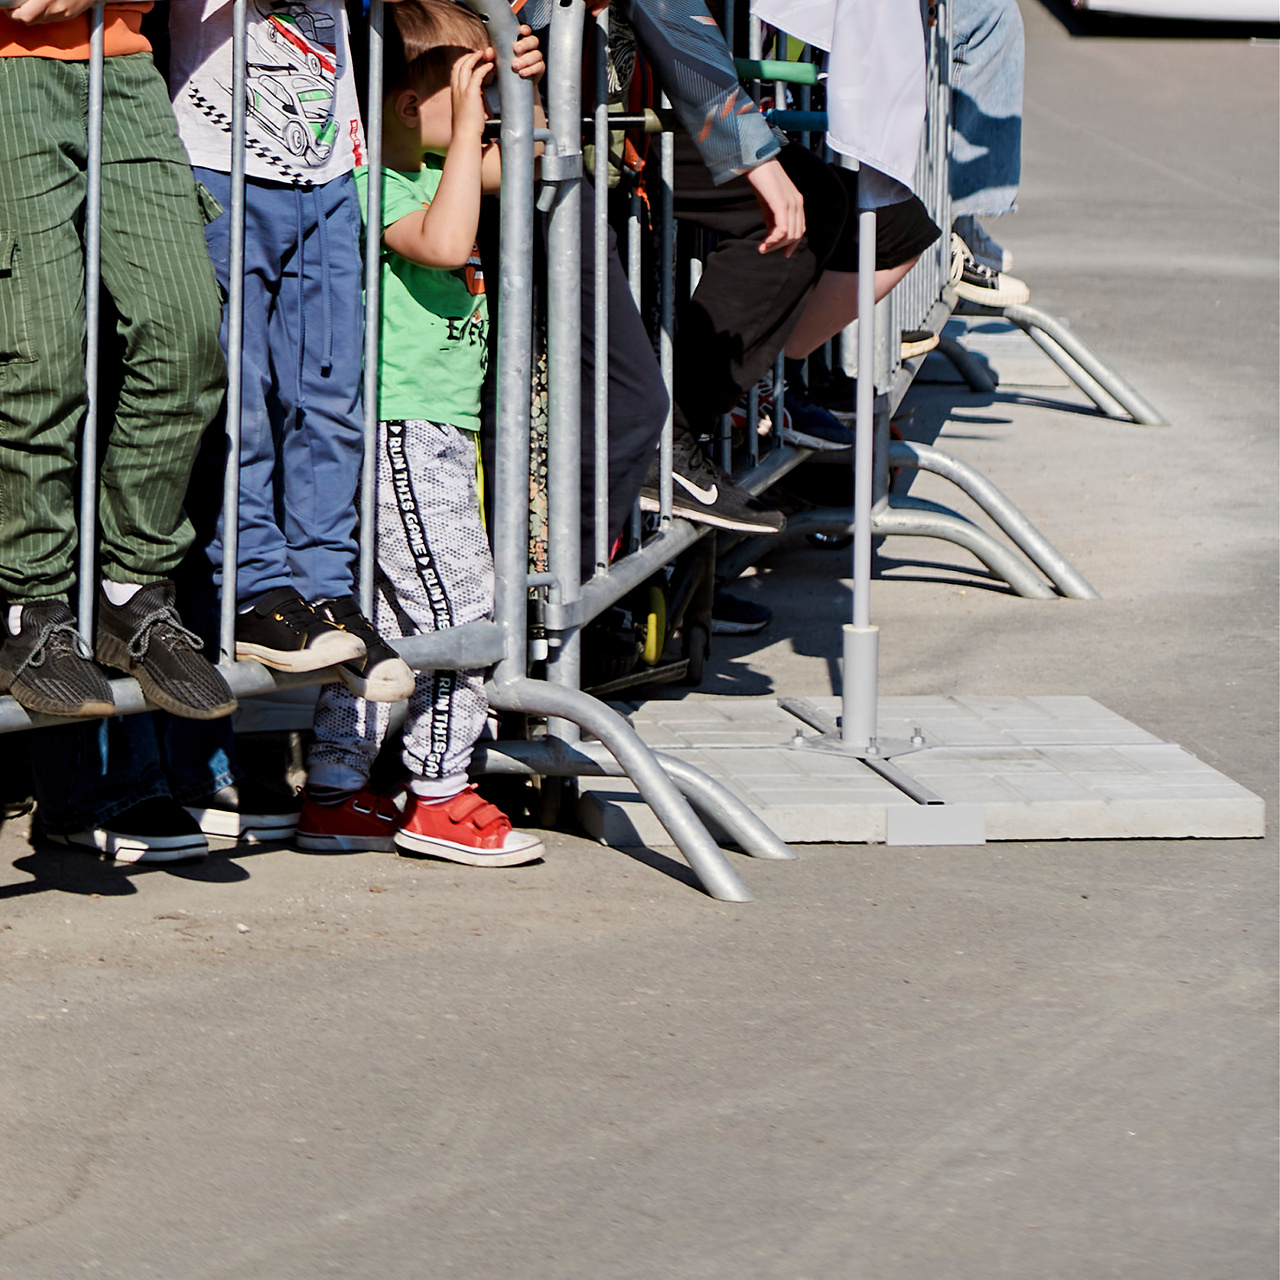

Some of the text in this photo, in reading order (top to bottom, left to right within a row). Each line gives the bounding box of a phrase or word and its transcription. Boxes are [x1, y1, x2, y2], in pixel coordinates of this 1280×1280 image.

[389, 437, 407, 471] RUN
[394, 471, 415, 512] THIS
[404, 513, 427, 557] GAME
[422, 568, 445, 601] RUN
[434, 677, 451, 711] RUN
[432, 713, 448, 754] THIS
